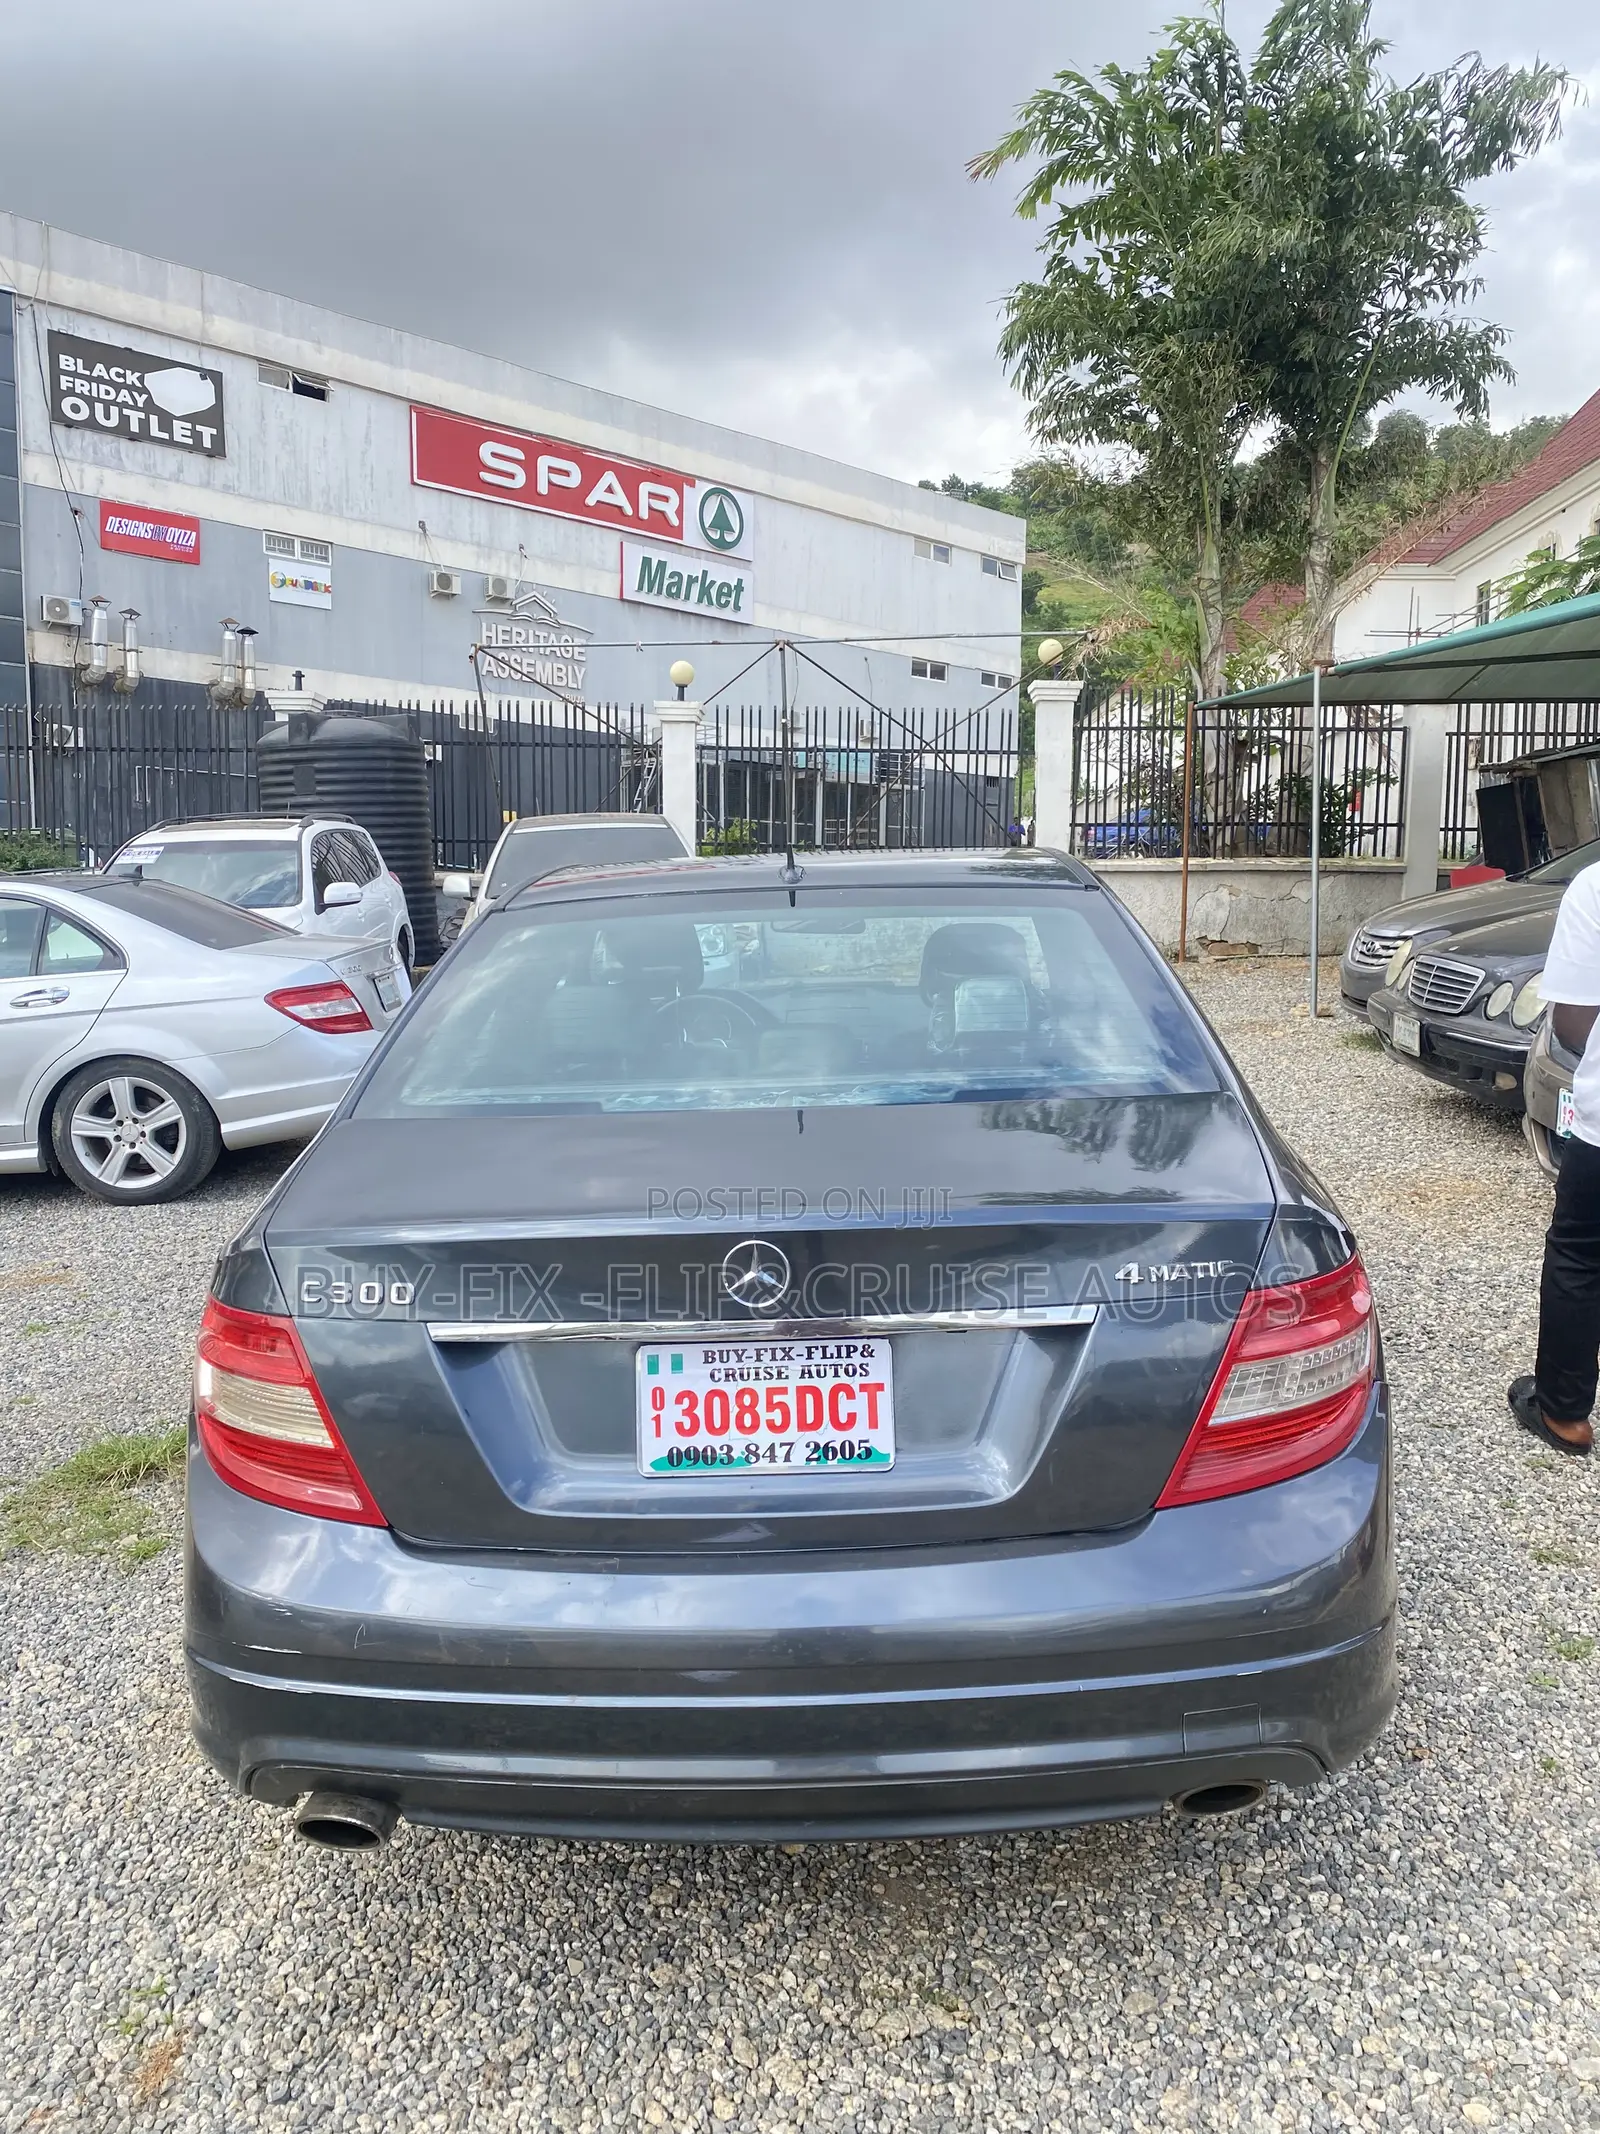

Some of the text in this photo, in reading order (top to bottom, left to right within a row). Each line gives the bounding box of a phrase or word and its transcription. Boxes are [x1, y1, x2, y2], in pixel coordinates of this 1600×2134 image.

[58, 353, 144, 388] BLACK
[58, 375, 149, 408] FRIDAY
[60, 397, 218, 449] OUTLET
[478, 440, 681, 528] SPAR
[105, 516, 153, 539] DESIGNS
[166, 527, 197, 547] OYIZA
[634, 555, 746, 613] Market
[481, 622, 587, 662] HERITAGE
[481, 652, 587, 690] ASSEMBLY
[703, 1343, 876, 1365] BUY-FIX-FLIP&
[709, 1362, 870, 1383] CRUISE AUTOS
[674, 1382, 885, 1437] 3085DCT
[667, 1439, 873, 1468] 0903 847 2605
